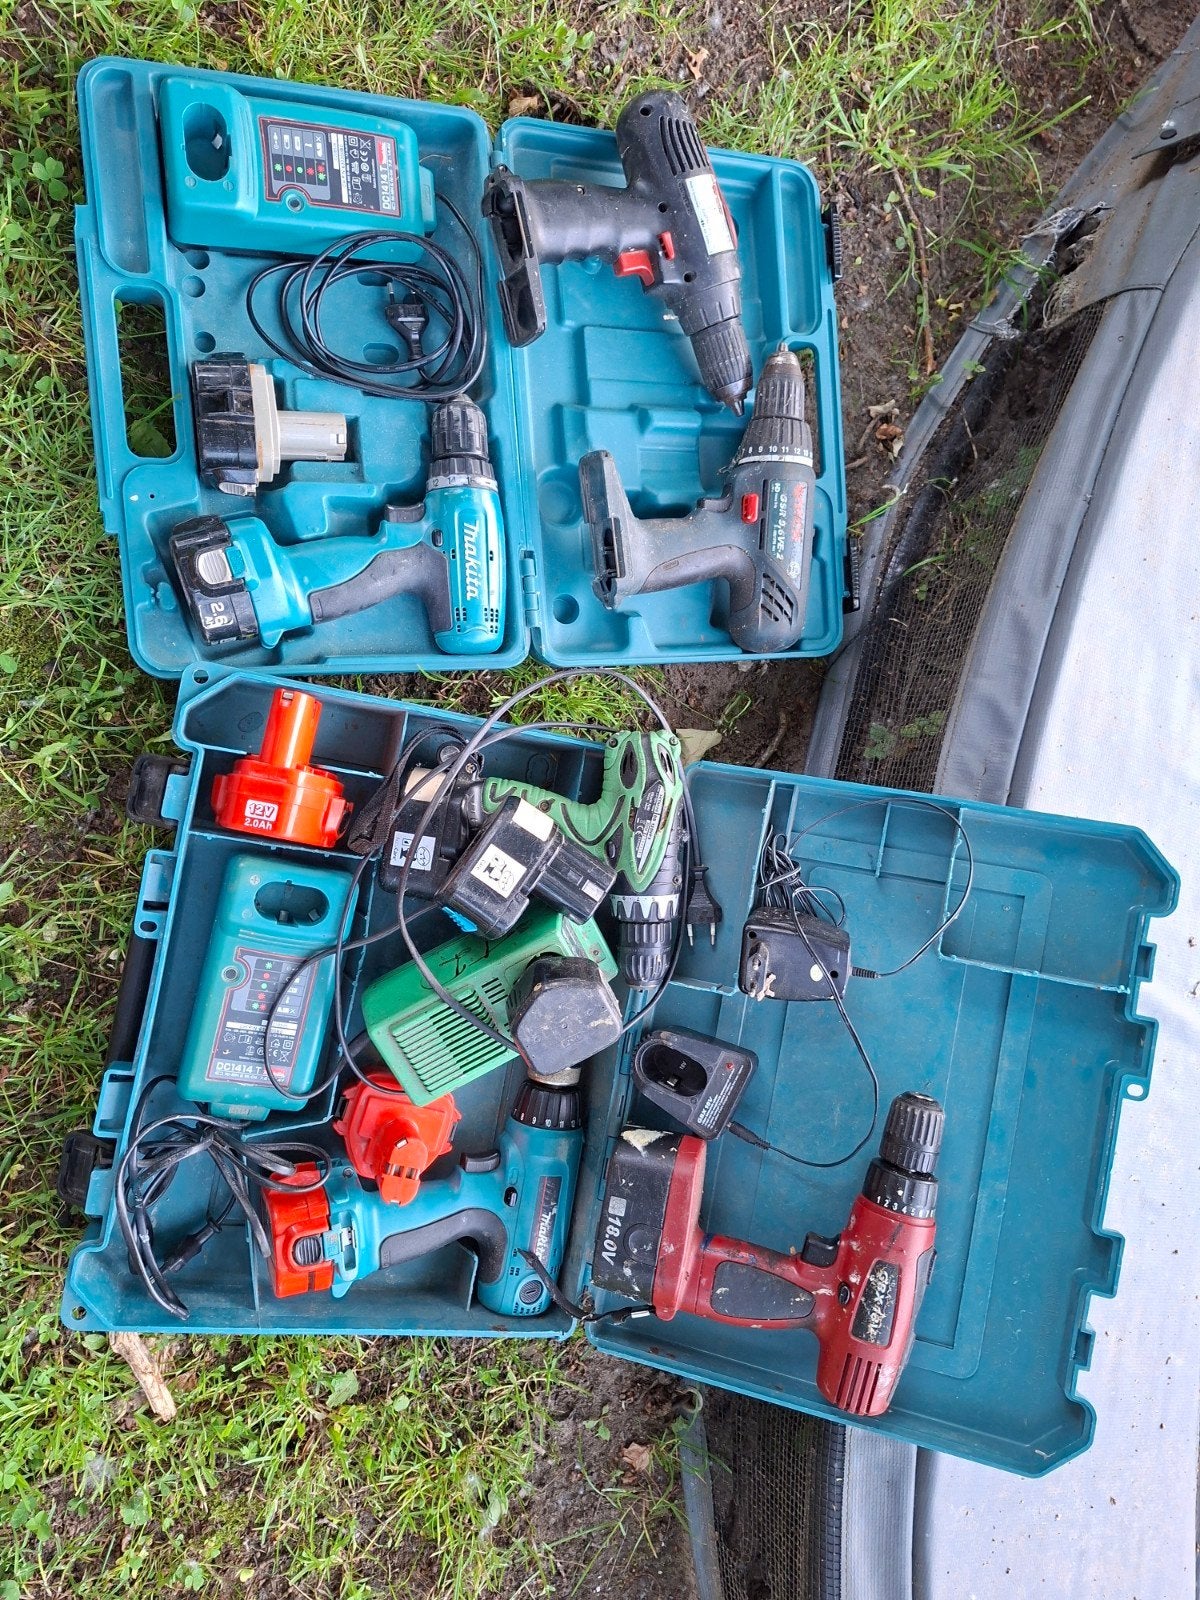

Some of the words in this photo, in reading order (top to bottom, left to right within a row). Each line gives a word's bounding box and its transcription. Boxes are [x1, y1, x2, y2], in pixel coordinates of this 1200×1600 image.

[769, 445, 778, 453] 10
[781, 445, 789, 453] 11
[248, 802, 275, 818] 12V
[244, 819, 273, 830] 2.0Ah
[216, 1062, 253, 1074] DC1414
[532, 1116, 537, 1125] 9
[877, 1195, 881, 1204] 1
[883, 1198, 889, 1208] 2
[893, 1202, 899, 1211] 3
[902, 1205, 907, 1214] 4
[911, 1207, 916, 1216] 5
[602, 1216, 621, 1266] 18.0V
